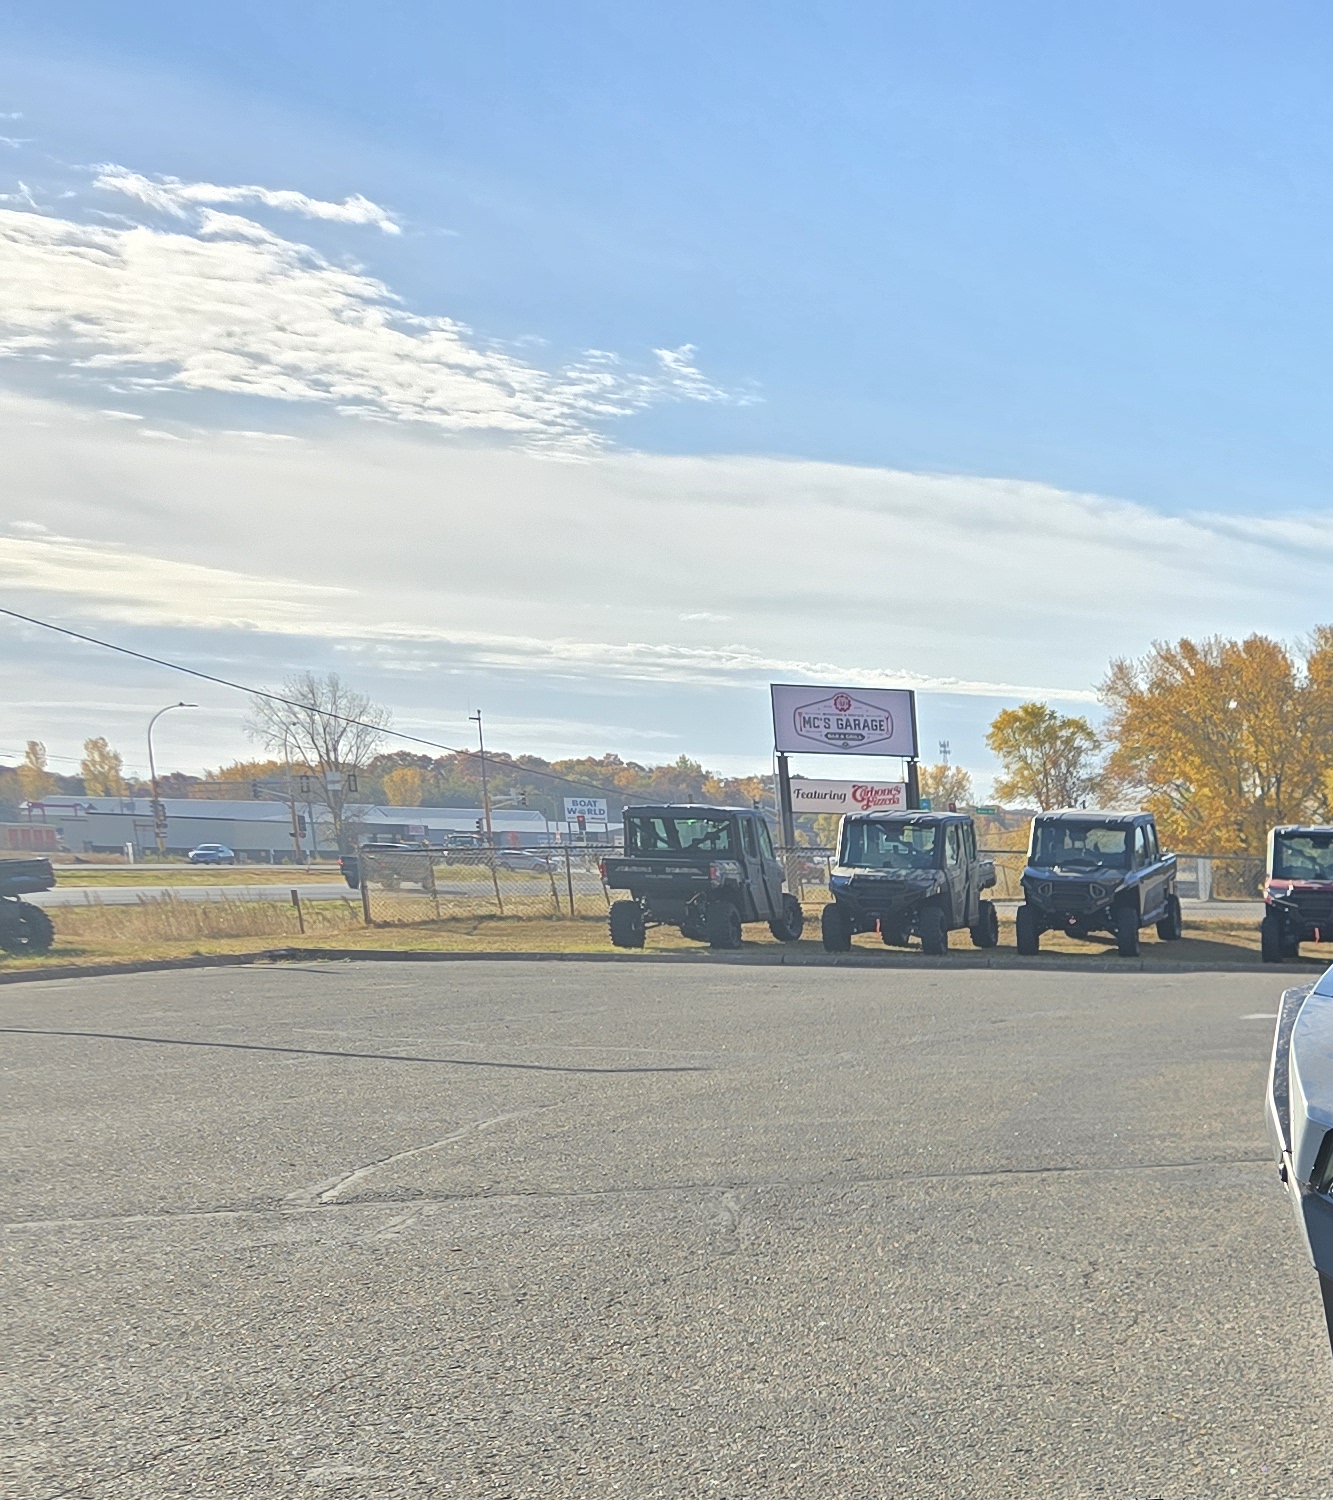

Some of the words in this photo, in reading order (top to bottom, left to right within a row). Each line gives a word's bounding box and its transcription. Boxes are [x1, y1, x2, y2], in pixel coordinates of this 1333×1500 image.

[802, 716, 831, 730] MC'S
[836, 717, 885, 731] GARAGE
[572, 799, 598, 807] BOAT
[793, 788, 847, 803] Featuring
